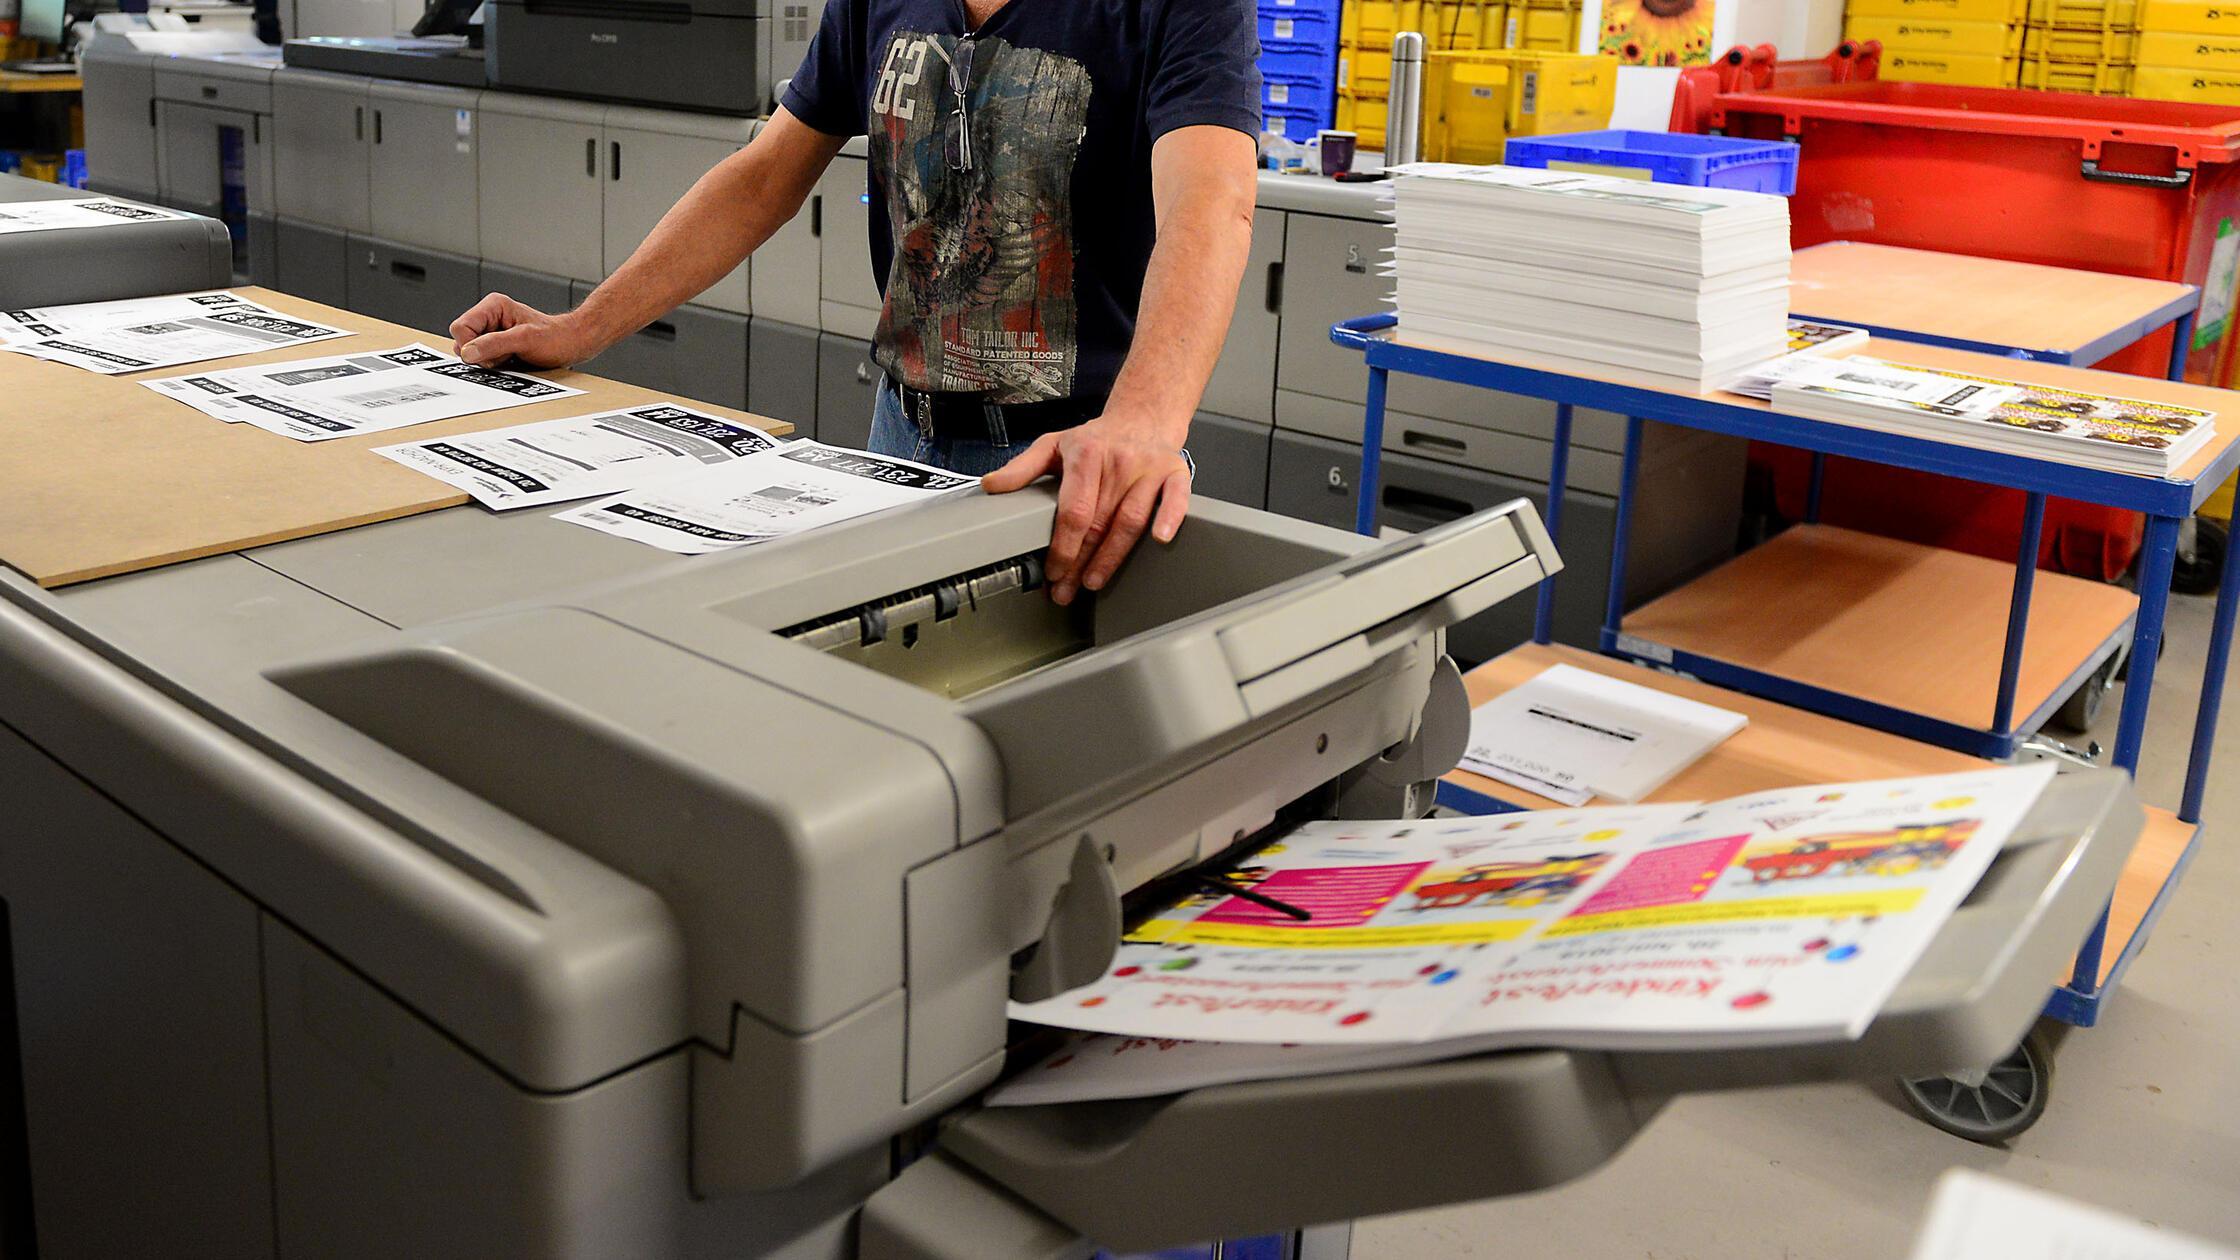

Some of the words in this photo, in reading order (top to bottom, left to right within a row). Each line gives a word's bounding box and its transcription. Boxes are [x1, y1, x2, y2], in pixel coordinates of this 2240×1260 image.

[873, 38, 927, 120] 62
[983, 331, 1018, 348] TAILOR
[1021, 331, 1039, 348] INC
[944, 341, 981, 357] STANDARD
[983, 350, 1030, 359] PATENTED
[1032, 351, 1064, 360] GOODS
[943, 353, 981, 367] ASSOCIATION
[796, 451, 829, 461] A4
[829, 460, 919, 483] 231.277
[1329, 467, 1341, 485] 6
